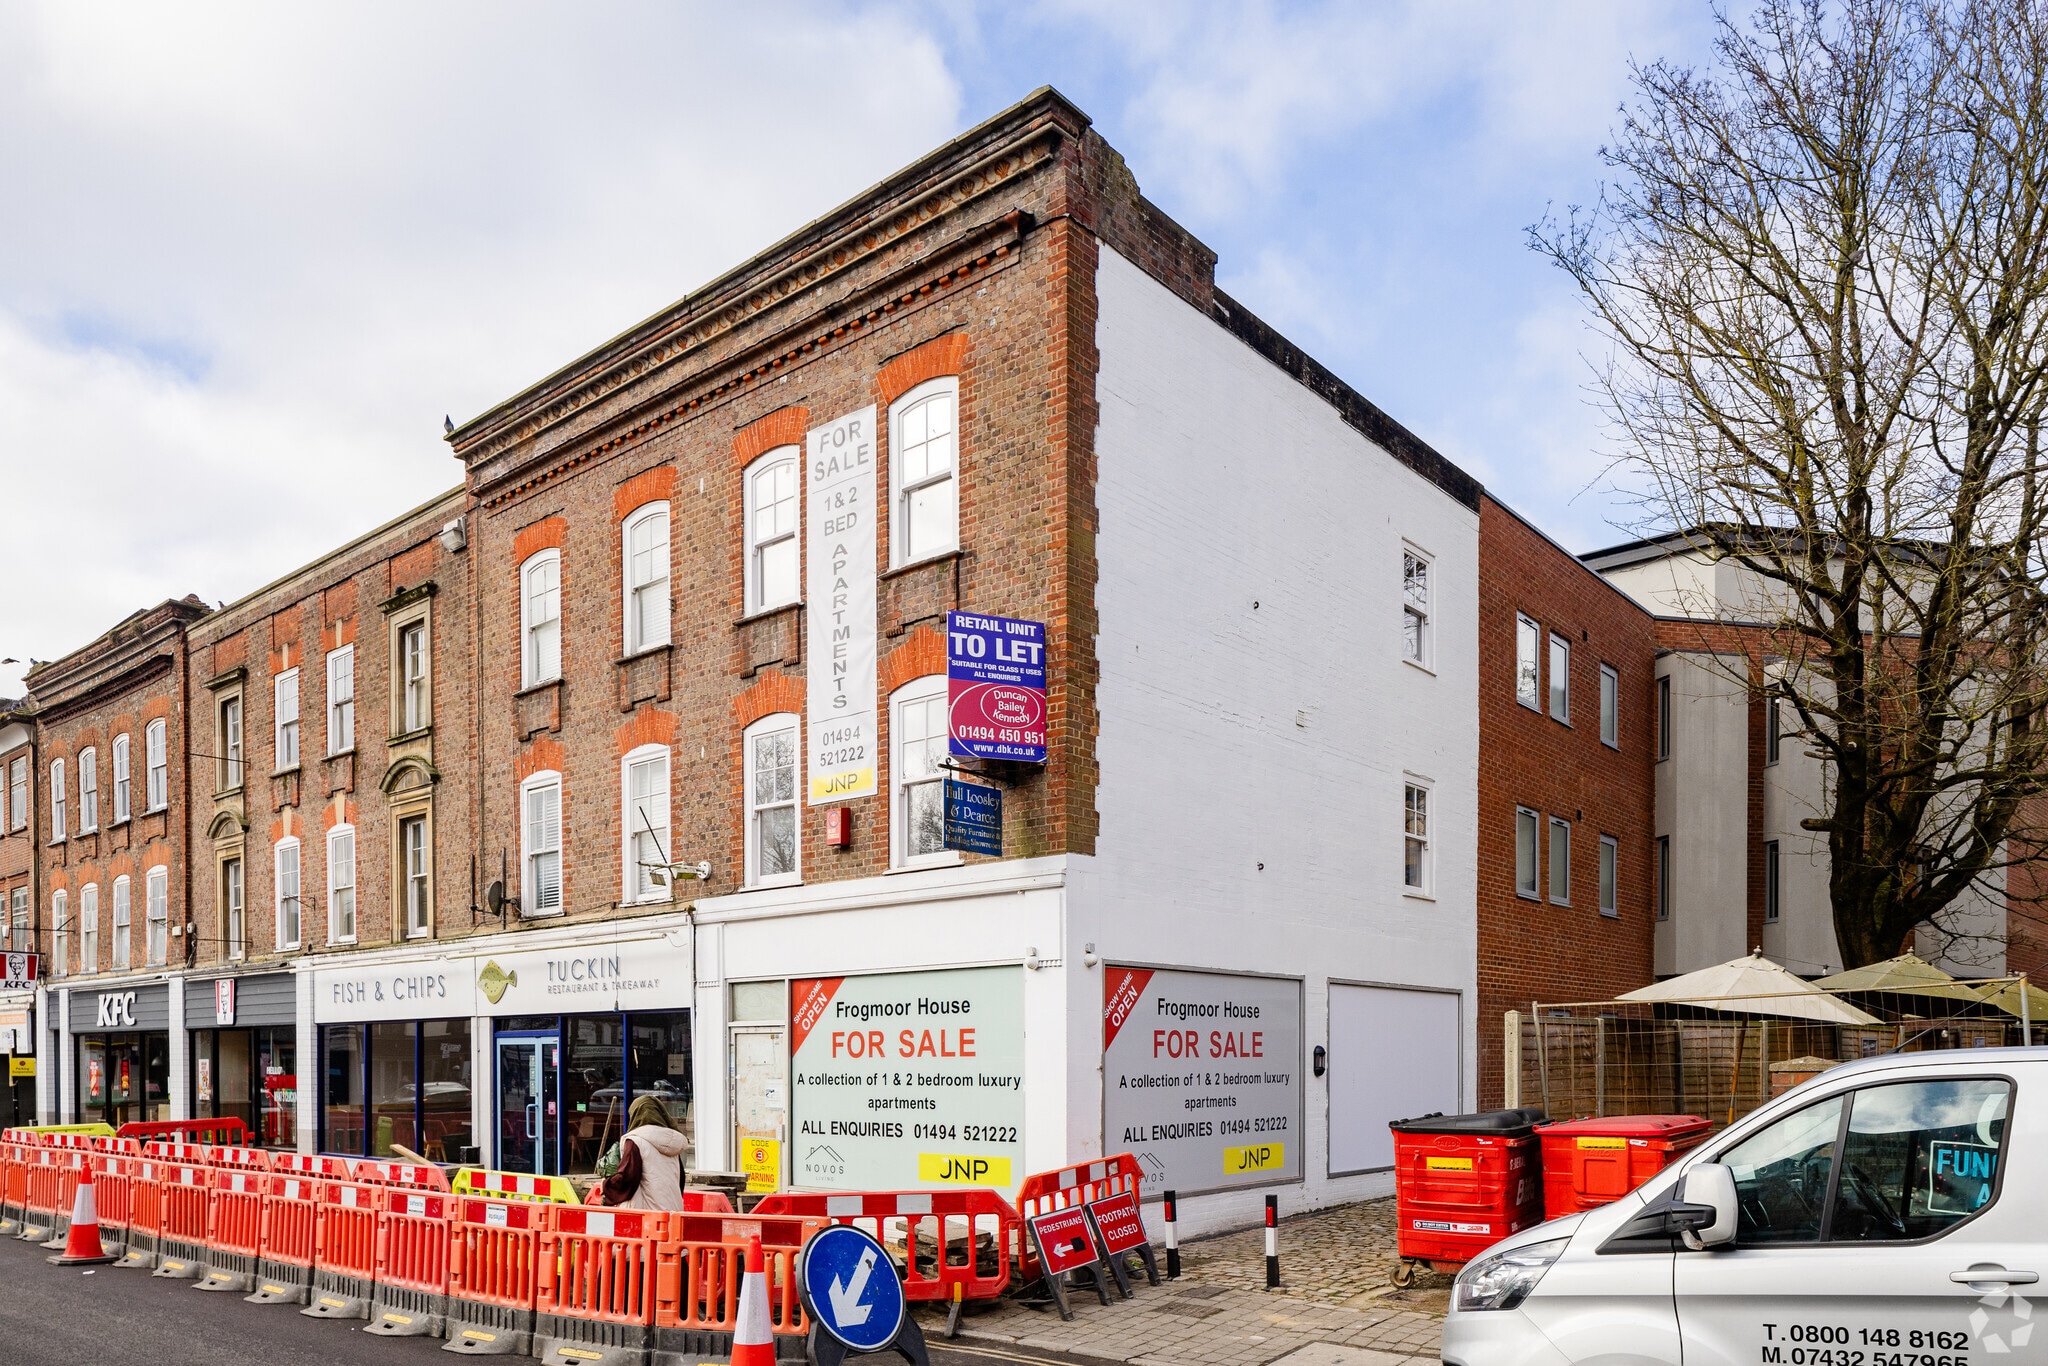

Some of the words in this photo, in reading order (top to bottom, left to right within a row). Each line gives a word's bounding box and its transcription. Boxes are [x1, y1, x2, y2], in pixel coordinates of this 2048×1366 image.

[819, 420, 862, 454] FOR
[814, 443, 869, 482] SALE
[824, 512, 857, 536] BED
[832, 543, 850, 709] APARTMENTS
[955, 615, 1003, 632] RETAIL
[1005, 622, 1037, 637] UNIT
[950, 632, 986, 657] TO
[995, 638, 1043, 665] LET
[951, 660, 982, 669] SUITABLE
[984, 663, 997, 671] FOR
[998, 665, 1018, 673] CLASS
[1026, 668, 1042, 676] USES
[987, 672, 1021, 682] ENQUIRIES
[993, 690, 1028, 703] Duncan
[992, 709, 1030, 724] Kennedy
[998, 701, 1025, 714] Bailey
[822, 726, 861, 746] 01494
[959, 725, 995, 741] 01494
[998, 728, 1020, 743] 450
[1024, 731, 1044, 745] 951
[820, 746, 864, 767] 521222
[973, 744, 1035, 756] www.dbk.co.uk
[825, 773, 858, 794] JNP
[966, 789, 1000, 811] Loosley
[950, 804, 960, 818] &
[963, 806, 996, 824] Pearce
[968, 828, 995, 839] Furniture
[547, 955, 621, 982] TUCKIN
[3, 980, 31, 989] KFC
[333, 981, 366, 1004] FISH
[374, 981, 384, 1002] &
[393, 974, 447, 1000] CHIPS
[547, 982, 599, 994] RESTAURANT
[602, 982, 608, 992] &
[611, 979, 660, 991] TAKEAWAY
[1105, 994, 1119, 1019] SHOW
[1117, 971, 1134, 996] HOME
[97, 991, 137, 1027] KFC
[793, 1001, 809, 1024] SHOW
[807, 980, 823, 1003] HOME
[801, 992, 828, 1031] OPEN
[836, 1001, 911, 1022] Frogmoor
[918, 997, 971, 1015] House
[1111, 985, 1138, 1027] OPEN
[1157, 997, 1220, 1021] Frogmoor
[1223, 1001, 1260, 1019] House
[832, 1030, 885, 1058] FOR
[898, 1028, 976, 1058] SALE
[1153, 1029, 1200, 1058] FOR
[1209, 1030, 1264, 1058] SALE
[797, 1073, 805, 1086] A
[808, 1072, 862, 1086] collection
[866, 1072, 878, 1086] of
[882, 1073, 887, 1086] 1
[893, 1073, 902, 1086] &
[906, 1073, 913, 1086] 2
[917, 1073, 973, 1087] bedroom
[978, 1073, 1021, 1090] luxury
[1119, 1075, 1128, 1089] A
[1130, 1074, 1180, 1088] collection
[1183, 1073, 1193, 1087] of
[1196, 1073, 1201, 1086] 1
[1204, 1073, 1212, 1086] &
[1215, 1073, 1220, 1086] 2
[1223, 1072, 1262, 1085] bedroom
[1264, 1071, 1290, 1086] luxury
[868, 1096, 936, 1111] apartments
[1184, 1095, 1237, 1112] apartments
[801, 1120, 826, 1135] ALL
[830, 1121, 904, 1138] ENQUIRIES
[913, 1123, 957, 1140] 01494
[963, 1125, 1017, 1143] 521222
[1123, 1127, 1148, 1143] ALL
[1152, 1121, 1213, 1141] ENQUIRIES
[1220, 1119, 1250, 1135] 01494
[1254, 1116, 1288, 1132] 521222
[751, 1139, 770, 1148] CODE
[1238, 1147, 1270, 1170] JNP
[805, 1164, 845, 1175] NOVOS
[940, 1158, 989, 1181] JNP
[1128, 1172, 1165, 1186] NVOS
[1038, 1216, 1083, 1235] PEDESTRIANS
[1097, 1206, 1136, 1226] FOOTPATH
[1107, 1223, 1138, 1241] CLOSED
[1858, 1328, 1901, 1347] 148
[1908, 1329, 1969, 1351] 8162
